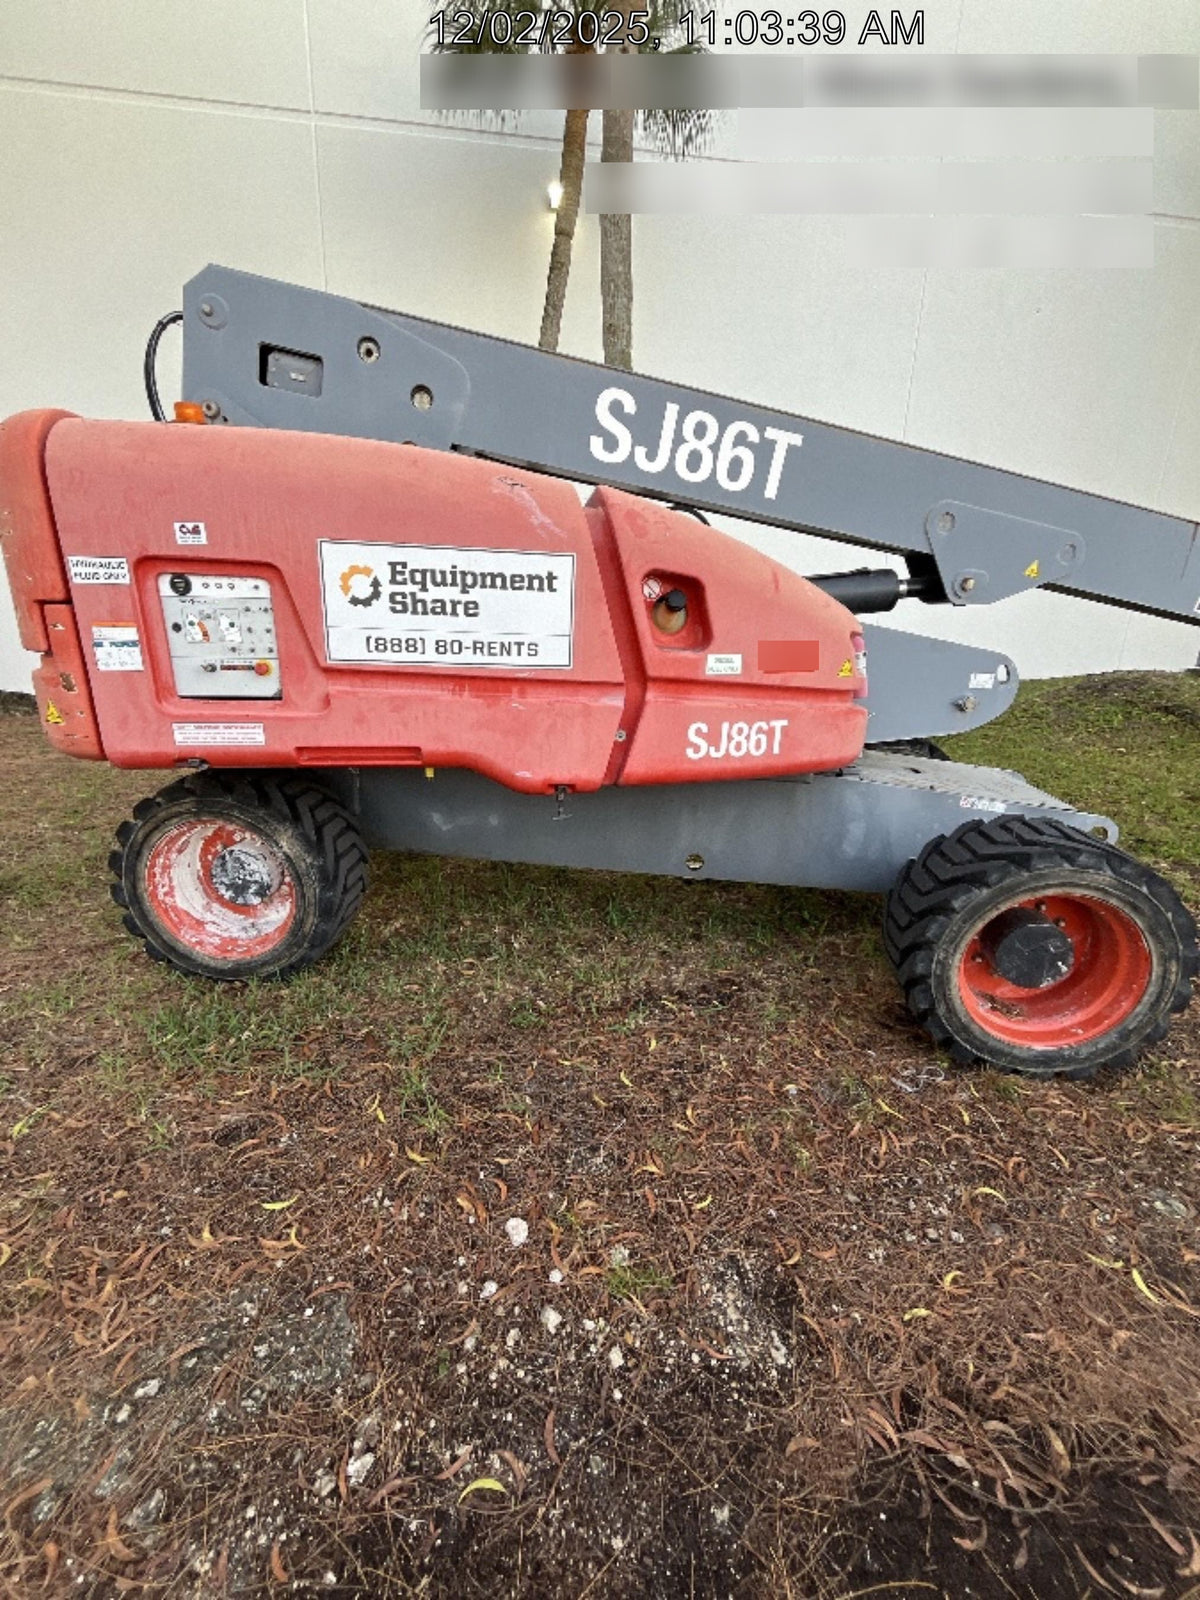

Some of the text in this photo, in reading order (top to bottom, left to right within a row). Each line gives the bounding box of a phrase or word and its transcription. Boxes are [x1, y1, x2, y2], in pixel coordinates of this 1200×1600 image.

[589, 387, 804, 501] SJ86T
[388, 561, 558, 594] Equipment
[388, 592, 480, 617] Share
[435, 639, 539, 657] 80-RENTS
[686, 720, 788, 760] SJ86T
